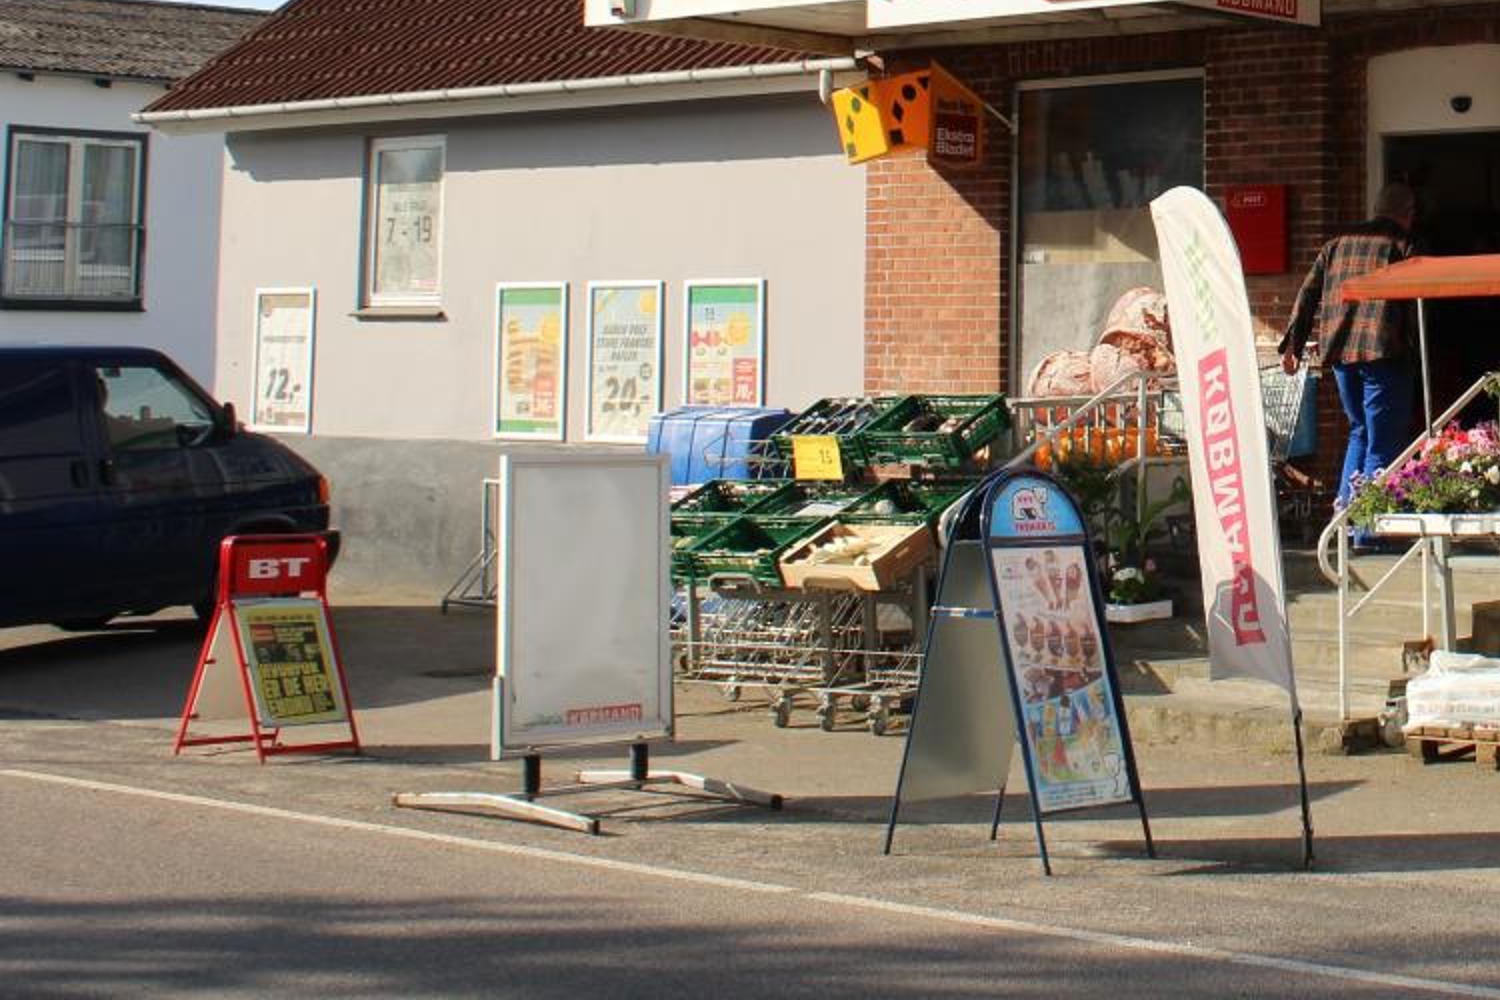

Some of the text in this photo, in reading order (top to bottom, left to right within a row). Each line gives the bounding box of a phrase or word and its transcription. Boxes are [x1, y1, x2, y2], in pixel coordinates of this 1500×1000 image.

[936, 127, 975, 143] Ekstra
[936, 141, 975, 158] Bladet
[247, 557, 311, 580] BT
